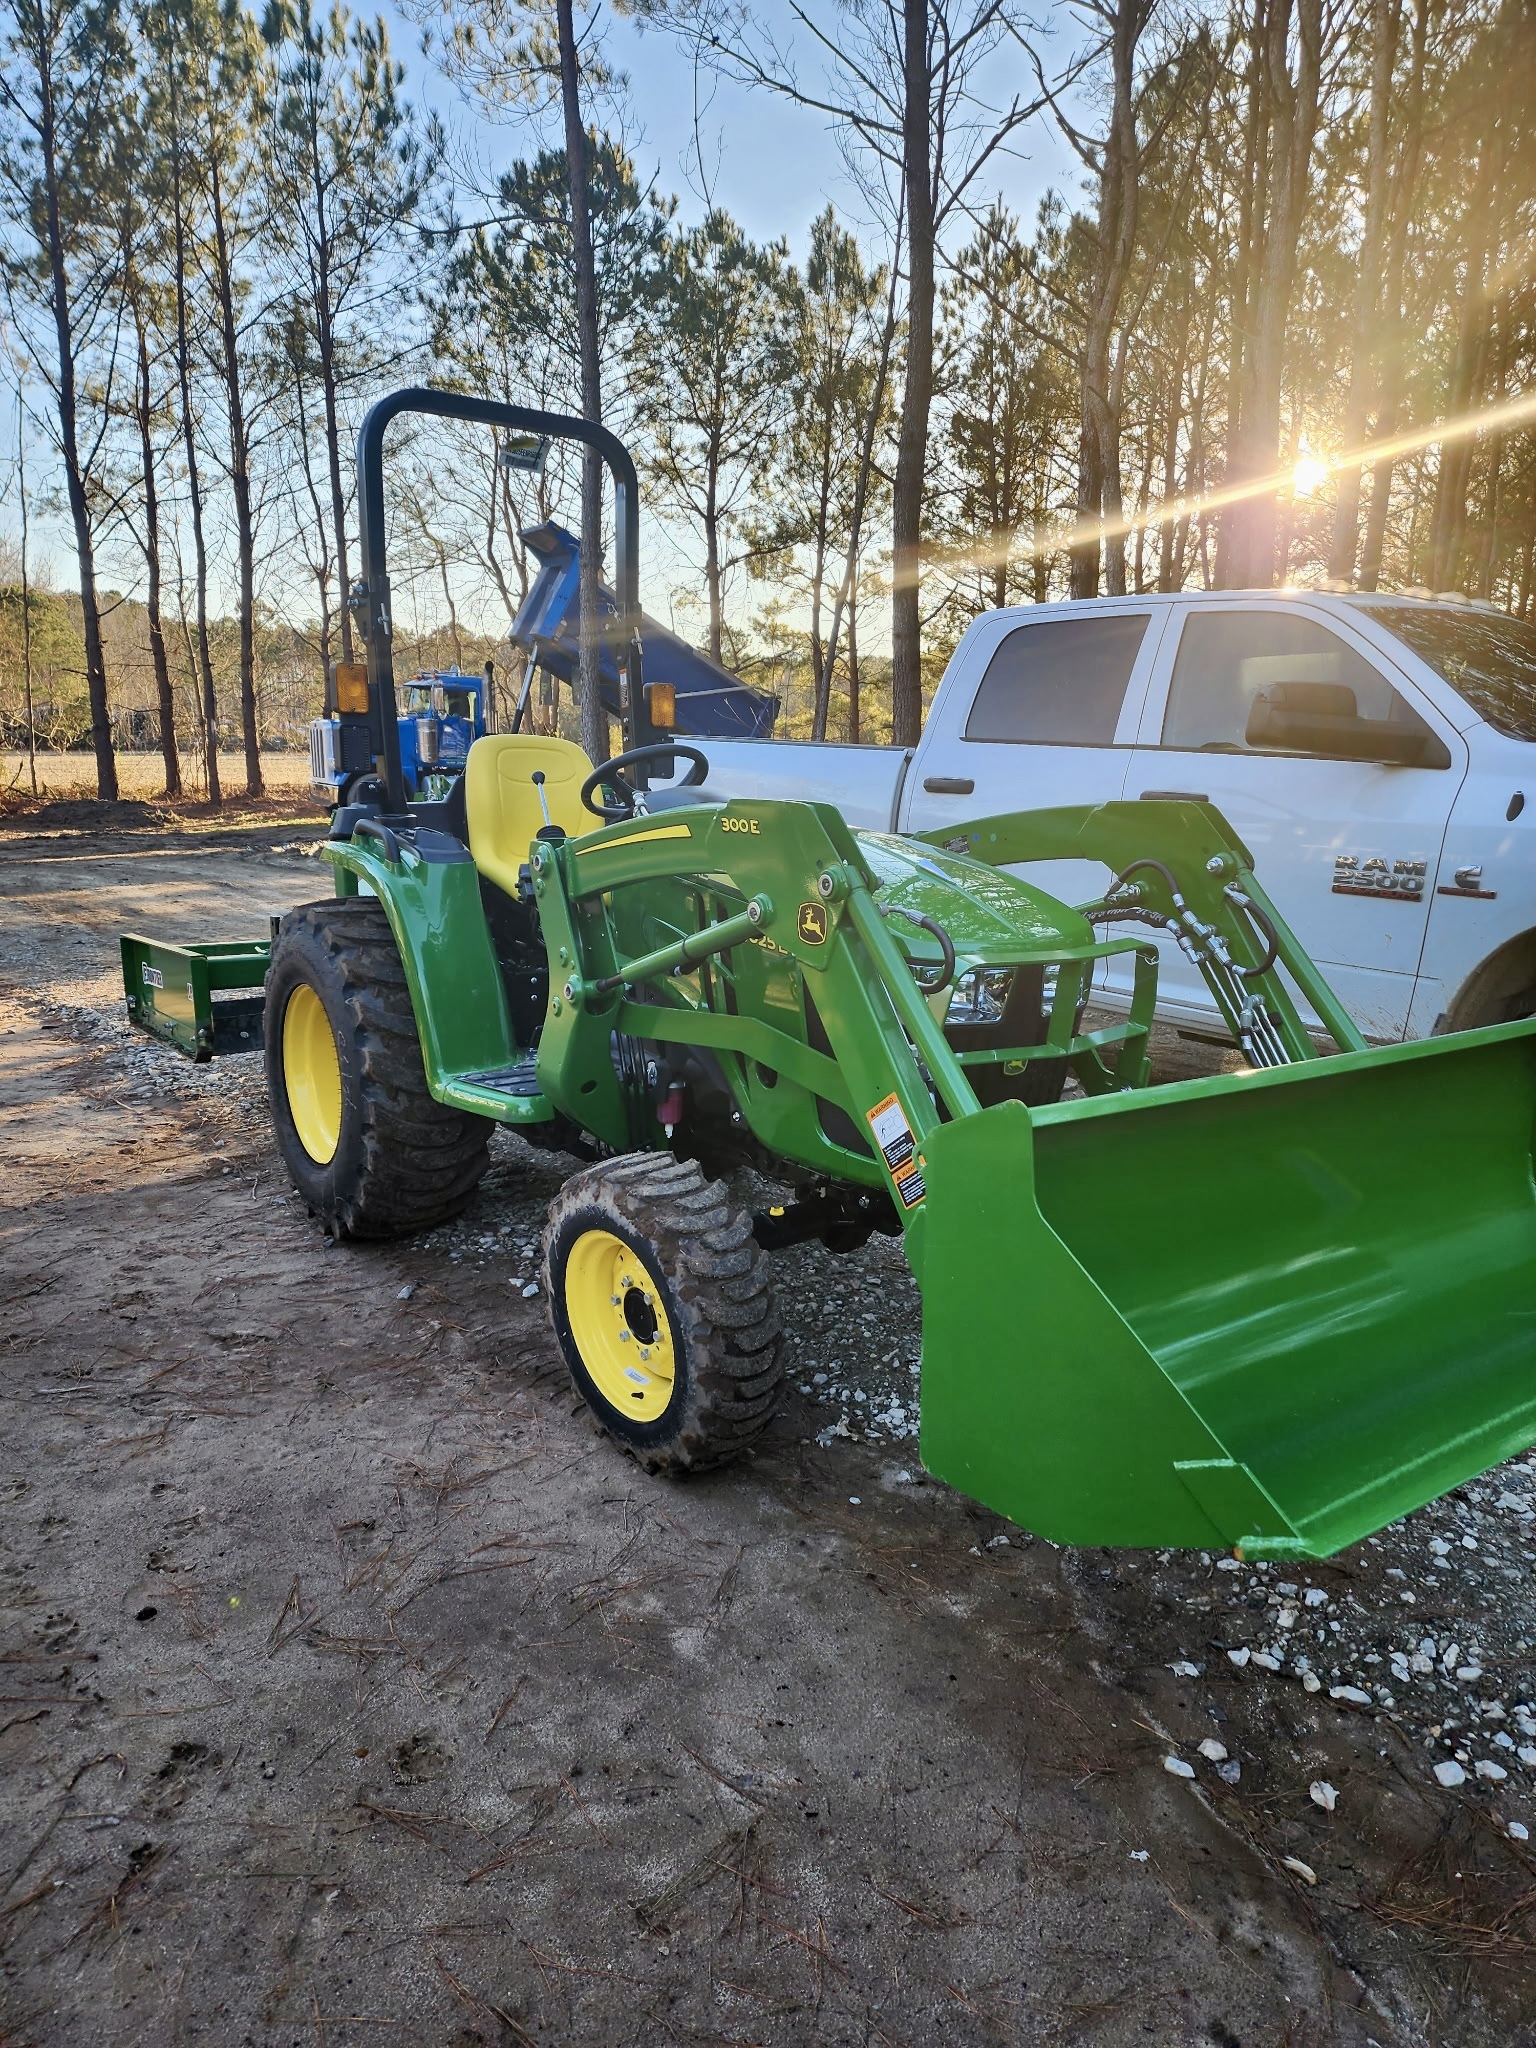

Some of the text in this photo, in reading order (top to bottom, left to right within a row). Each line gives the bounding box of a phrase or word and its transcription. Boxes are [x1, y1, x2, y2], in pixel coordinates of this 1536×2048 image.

[1335, 856, 1427, 876] RAM
[1332, 870, 1425, 892] 2500
[875, 1097, 894, 1114] WARNING
[901, 1165, 917, 1178] WARN
